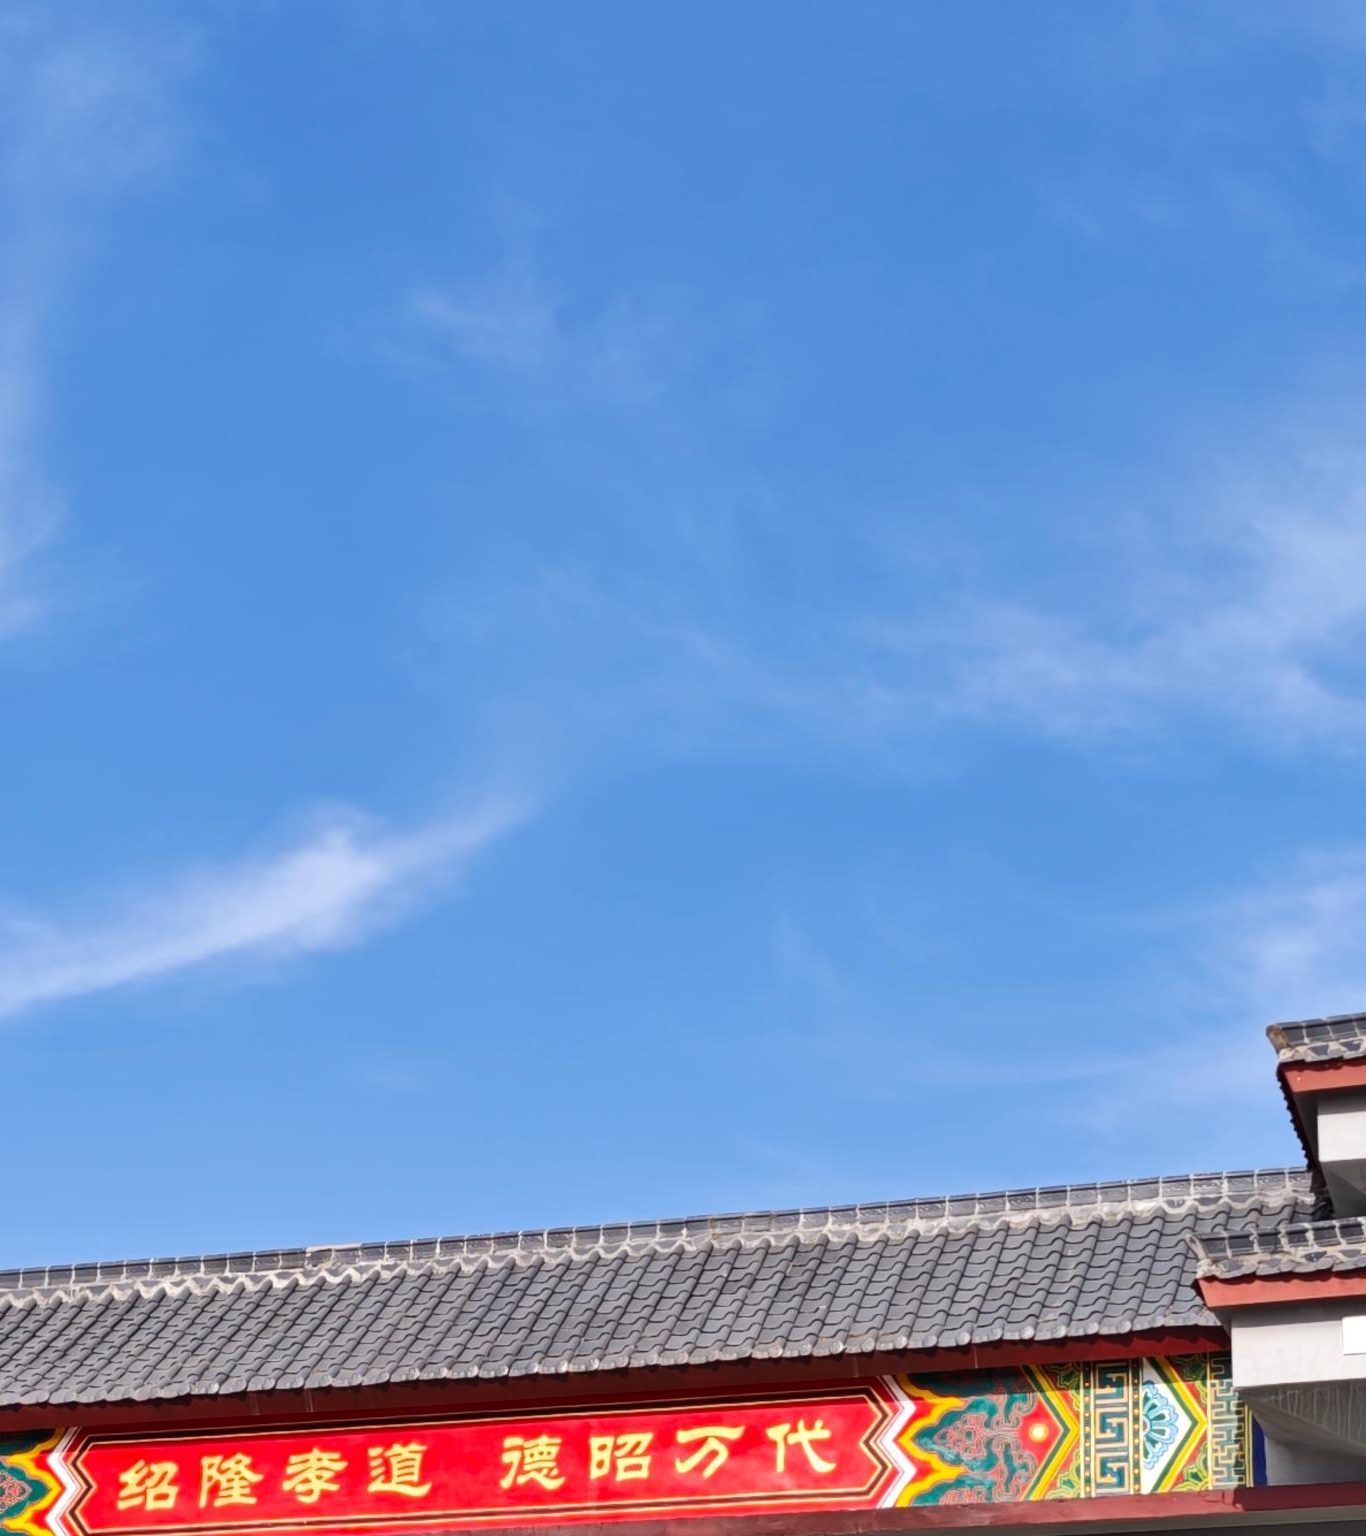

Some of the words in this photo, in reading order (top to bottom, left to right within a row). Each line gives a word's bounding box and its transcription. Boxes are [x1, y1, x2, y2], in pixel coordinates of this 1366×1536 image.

[116, 1441, 433, 1511] 绍隆孝道
[499, 1418, 837, 1491] 德昭万代
